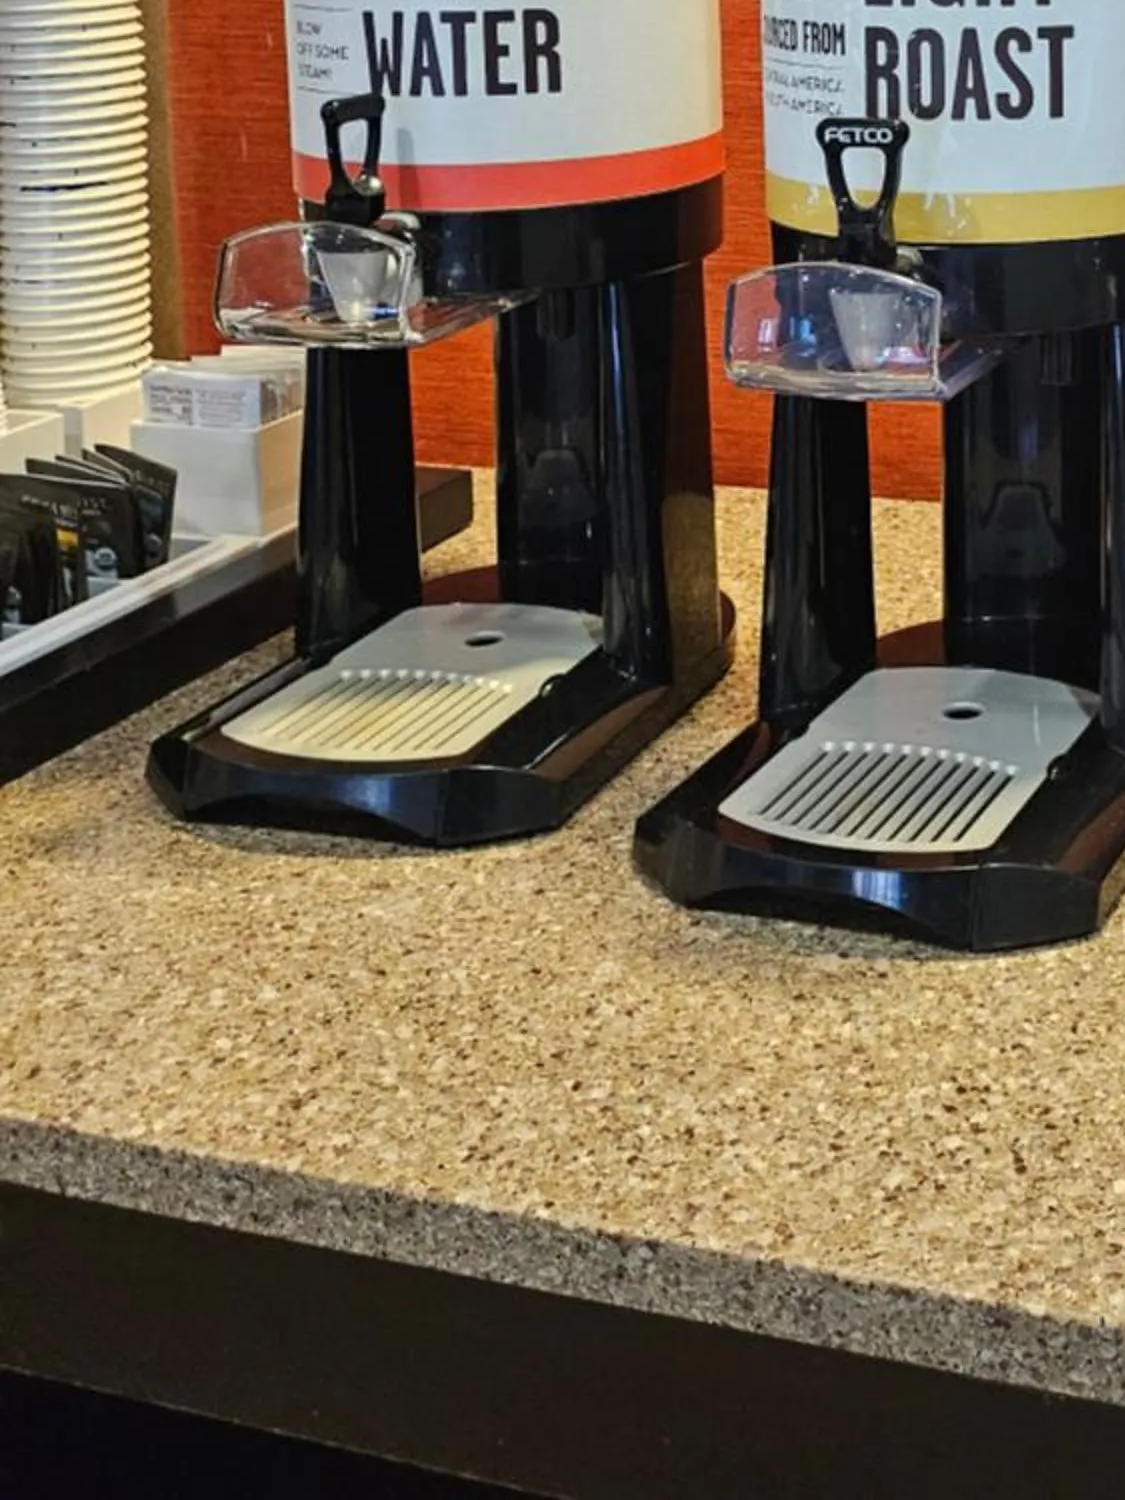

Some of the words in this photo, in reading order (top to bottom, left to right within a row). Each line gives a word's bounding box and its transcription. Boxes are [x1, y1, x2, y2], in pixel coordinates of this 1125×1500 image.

[363, 9, 563, 97] WATER
[802, 20, 846, 56] FROM
[864, 26, 1075, 122] ROAST
[823, 127, 894, 144] FETCO
